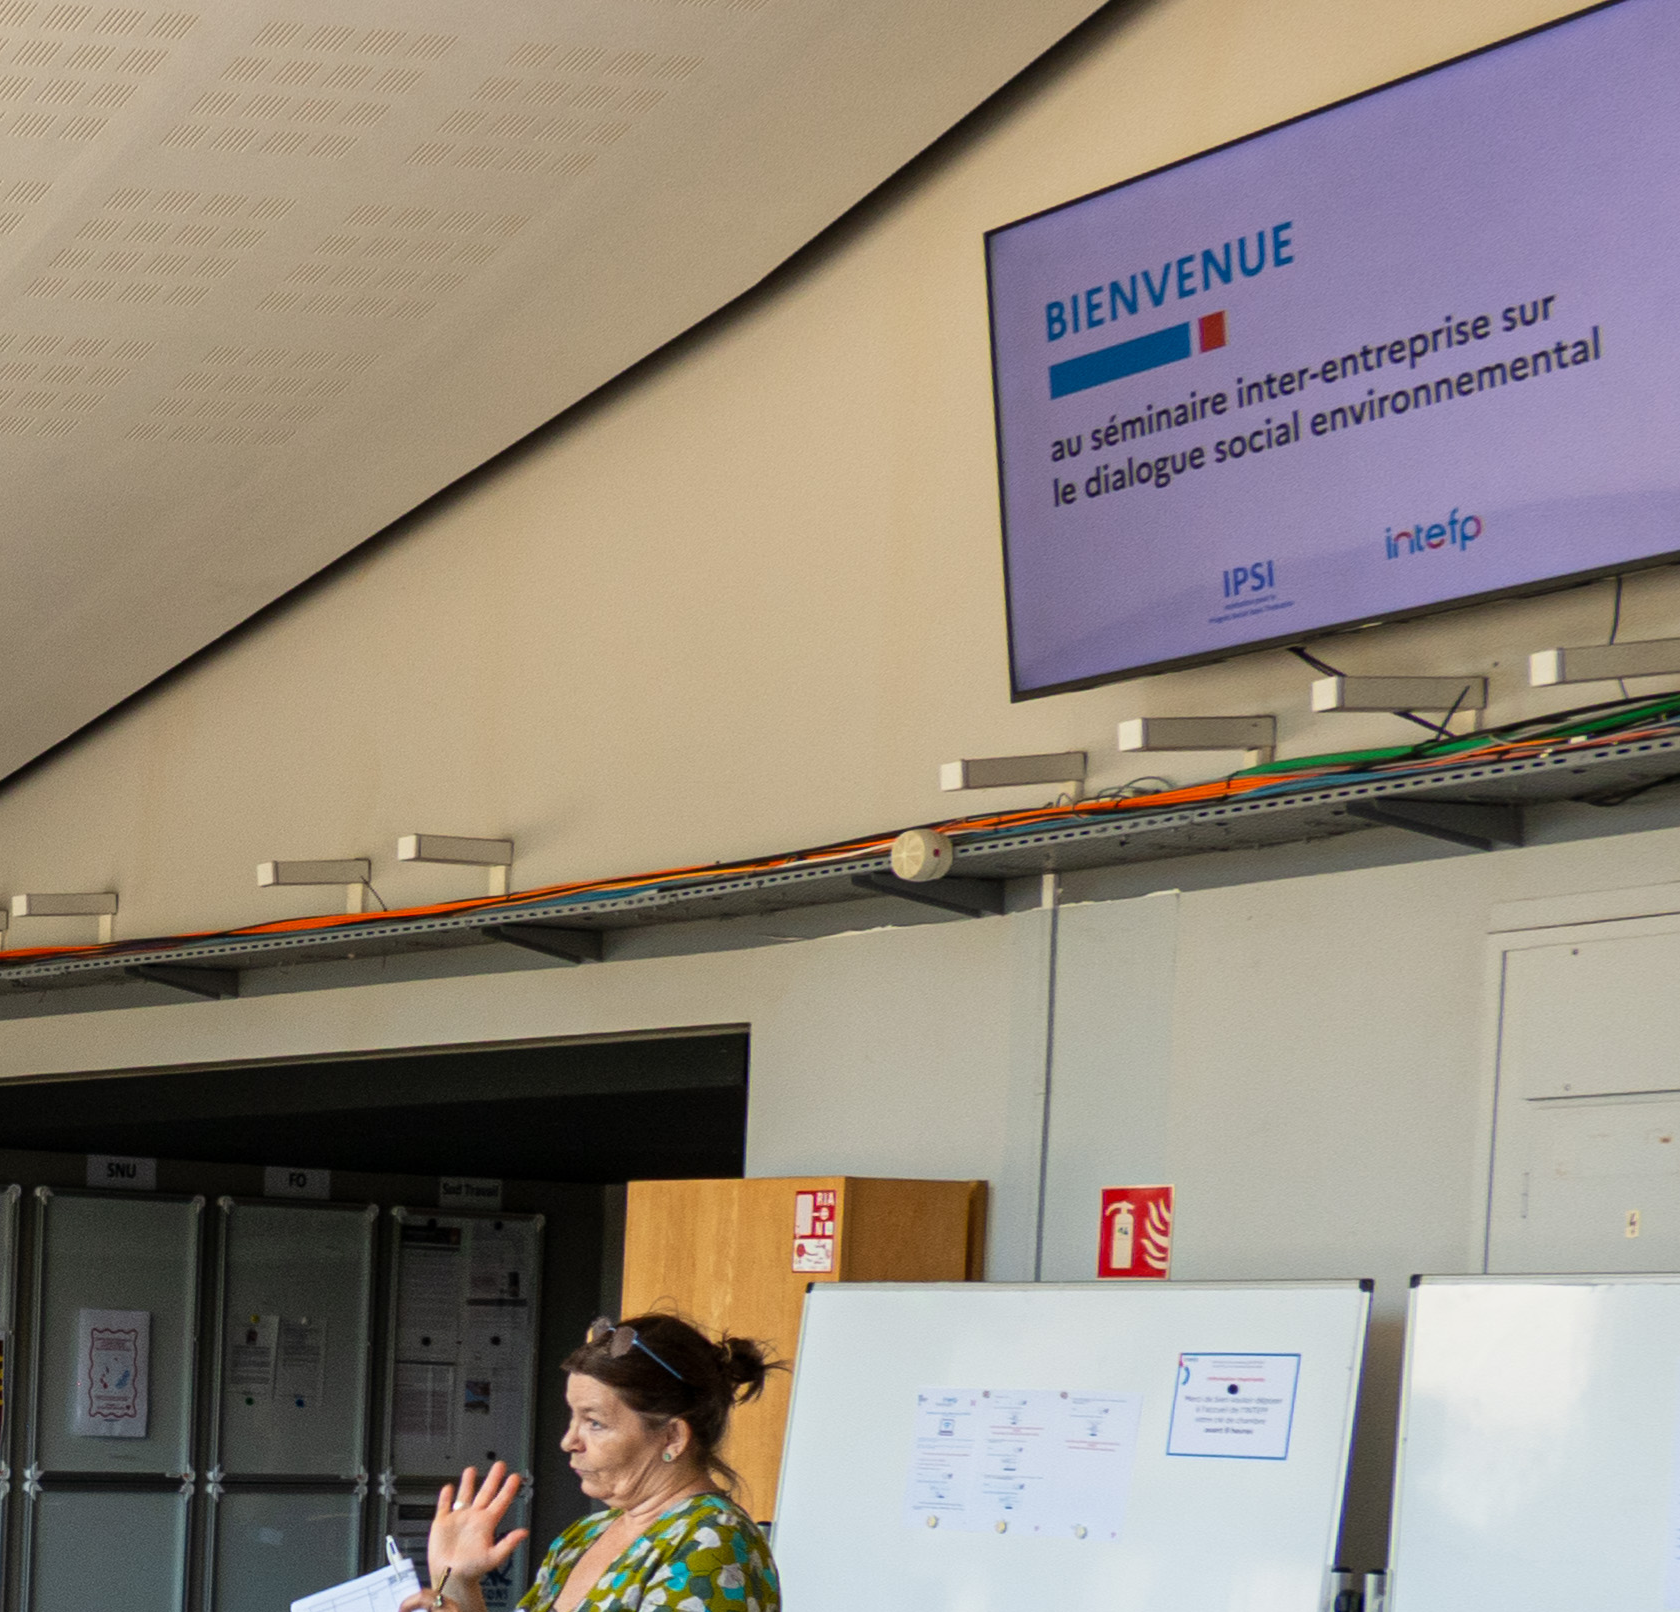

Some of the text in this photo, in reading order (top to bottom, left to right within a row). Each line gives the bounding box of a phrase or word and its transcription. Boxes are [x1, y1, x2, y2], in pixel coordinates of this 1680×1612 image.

[1045, 221, 1294, 342] BIENVENUE
[1051, 294, 1555, 462] au séminaire inter-entreprise sur
[1053, 325, 1601, 507] le dialogue social environnemental
[1385, 507, 1482, 559] intefp
[1223, 560, 1275, 597] IPSI
[107, 1162, 136, 1179] SNU
[289, 1173, 307, 1188] FO
